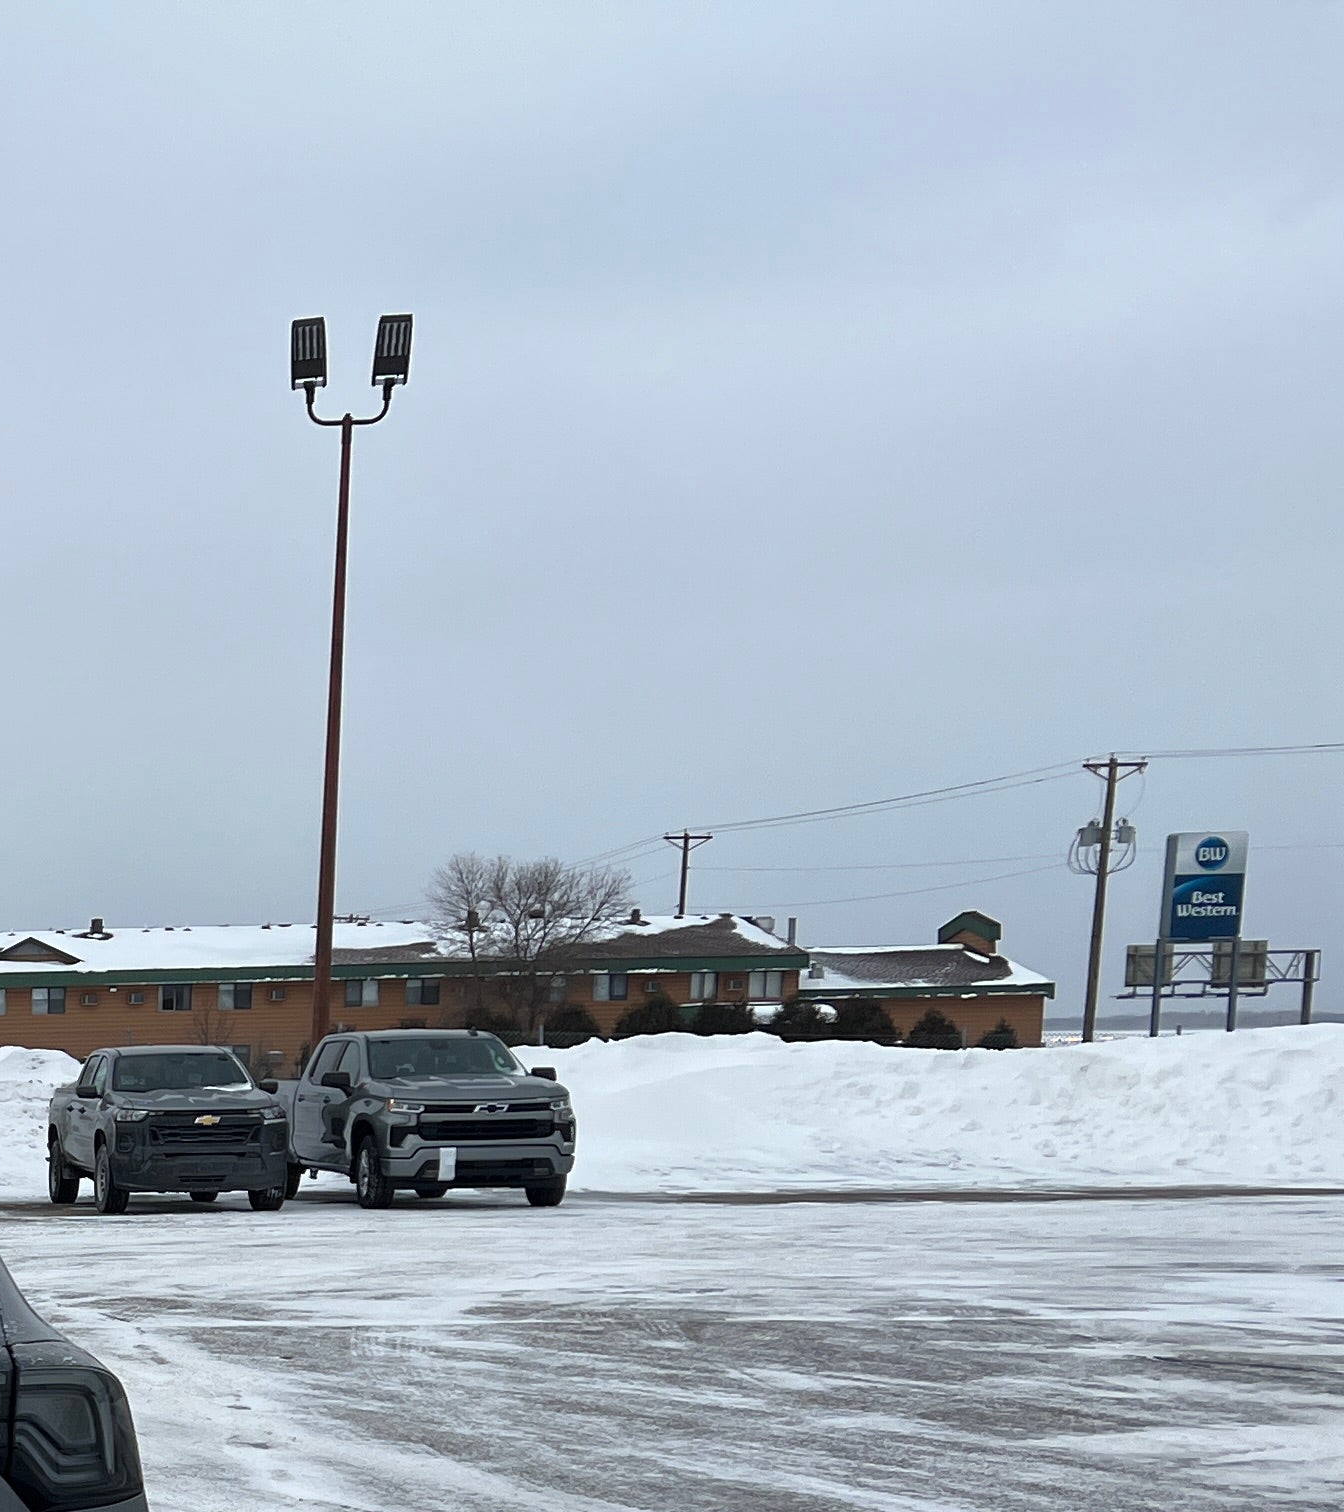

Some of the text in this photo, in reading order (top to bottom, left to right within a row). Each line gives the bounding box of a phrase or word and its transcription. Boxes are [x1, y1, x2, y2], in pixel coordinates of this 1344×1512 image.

[1198, 847, 1226, 861] BW
[1192, 891, 1225, 903] Best
[1177, 904, 1236, 917] Western
